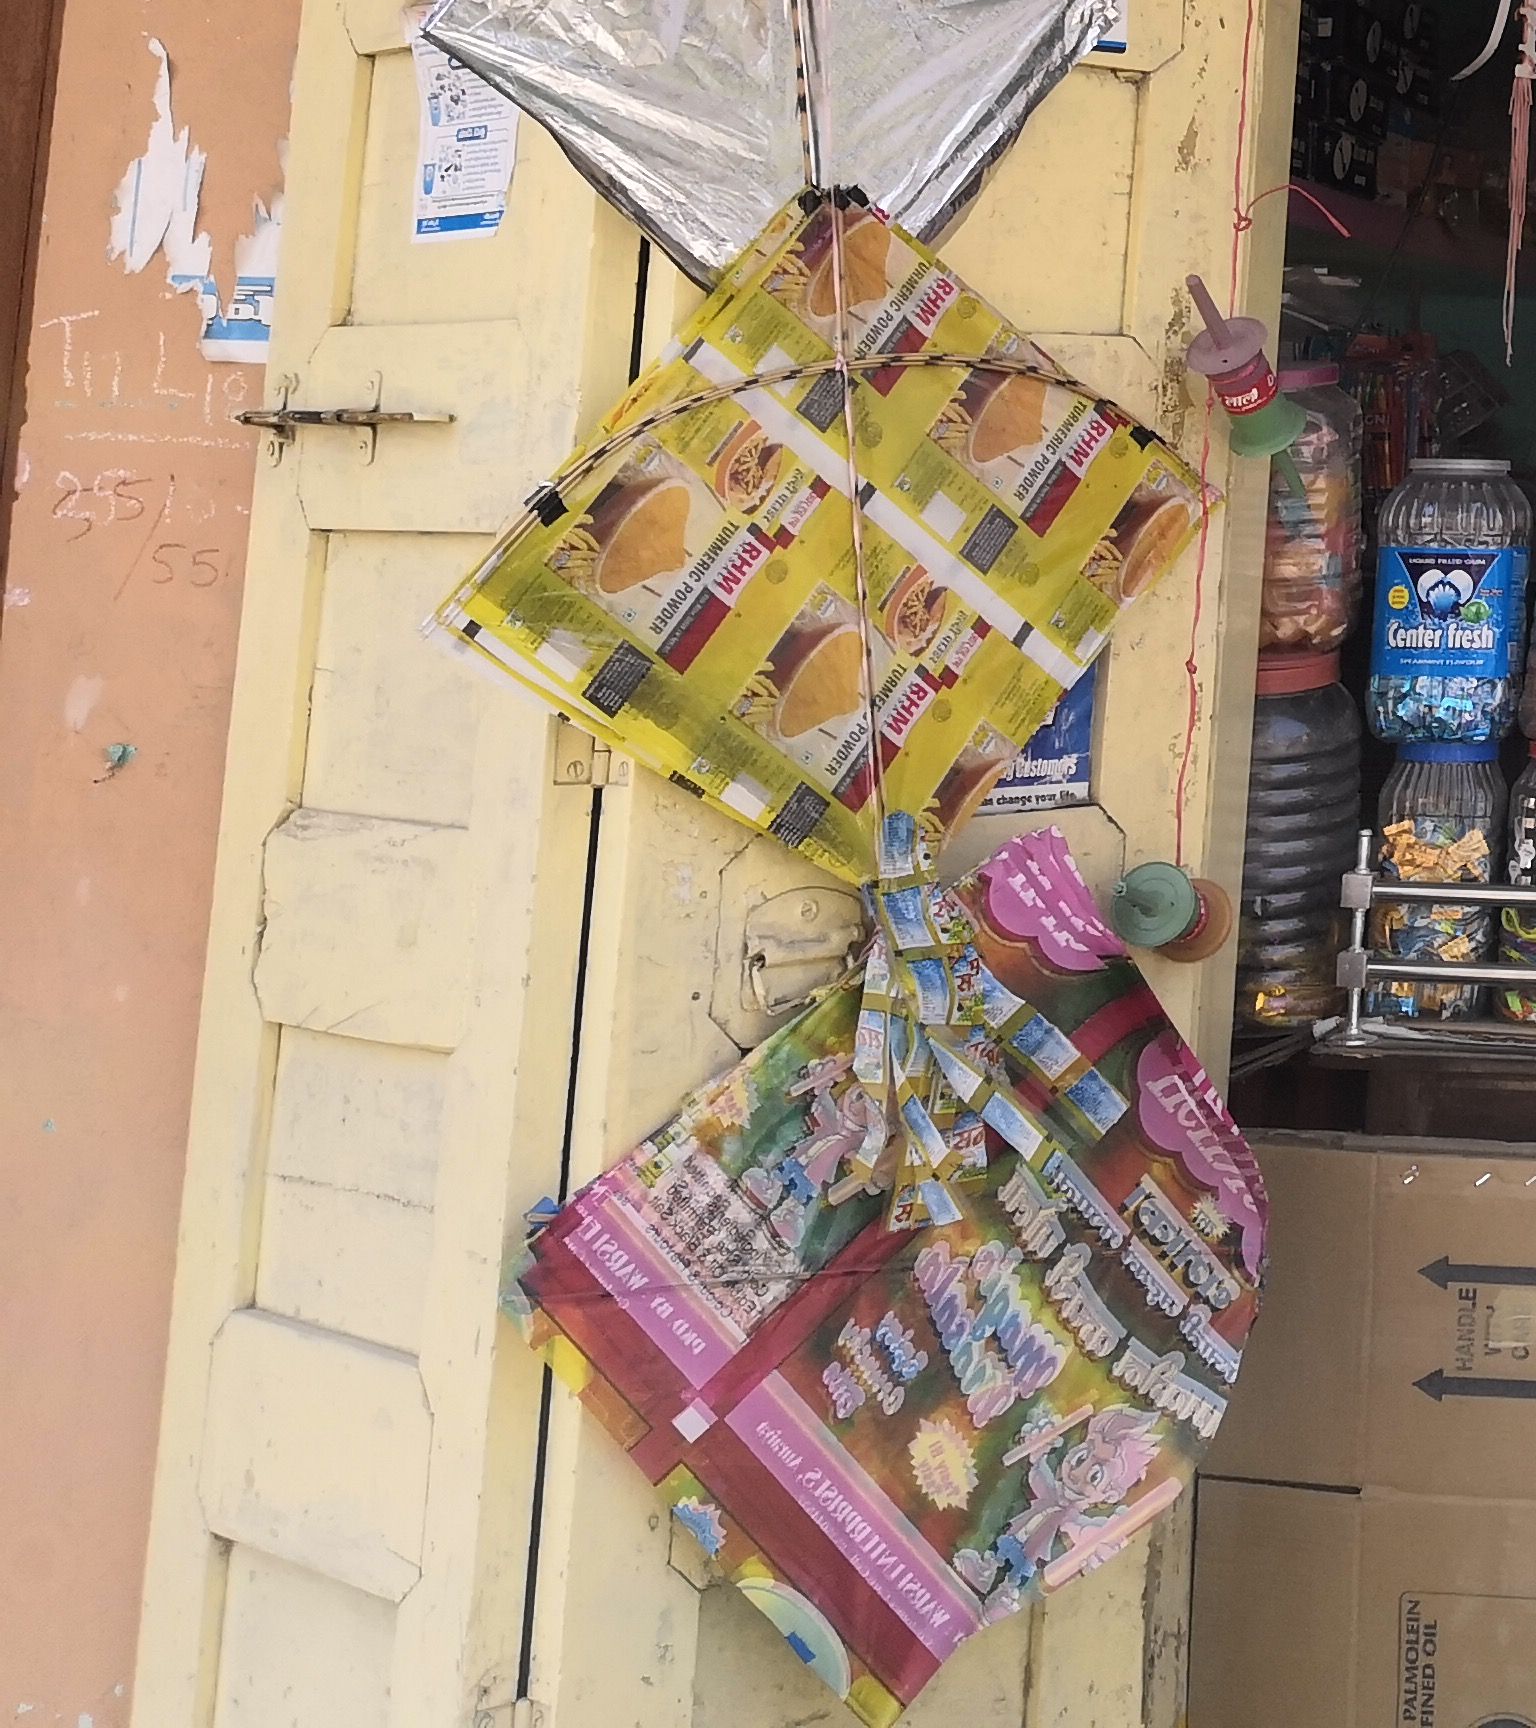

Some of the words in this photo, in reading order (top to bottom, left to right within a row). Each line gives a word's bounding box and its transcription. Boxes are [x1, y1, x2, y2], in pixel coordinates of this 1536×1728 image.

[914, 277, 957, 327] RHM
[854, 309, 896, 360] POWDER
[1044, 399, 1089, 456] TURMERIC
[1067, 419, 1108, 468] RHM
[1012, 452, 1051, 503] POWDER
[688, 519, 741, 586] TURMERIC
[715, 539, 762, 596] RHM
[649, 580, 693, 636] POWDER
[1388, 622, 1443, 648] Center
[1447, 622, 1494, 649] fresh
[885, 681, 930, 738] RHM
[823, 721, 868, 778] POWDER
[996, 794, 1033, 807] change
[1034, 792, 1057, 805] your
[1455, 1288, 1477, 1371] HANDLE
[1403, 1600, 1420, 1720] PALMOLEIN
[1423, 1620, 1437, 1656] OIL
